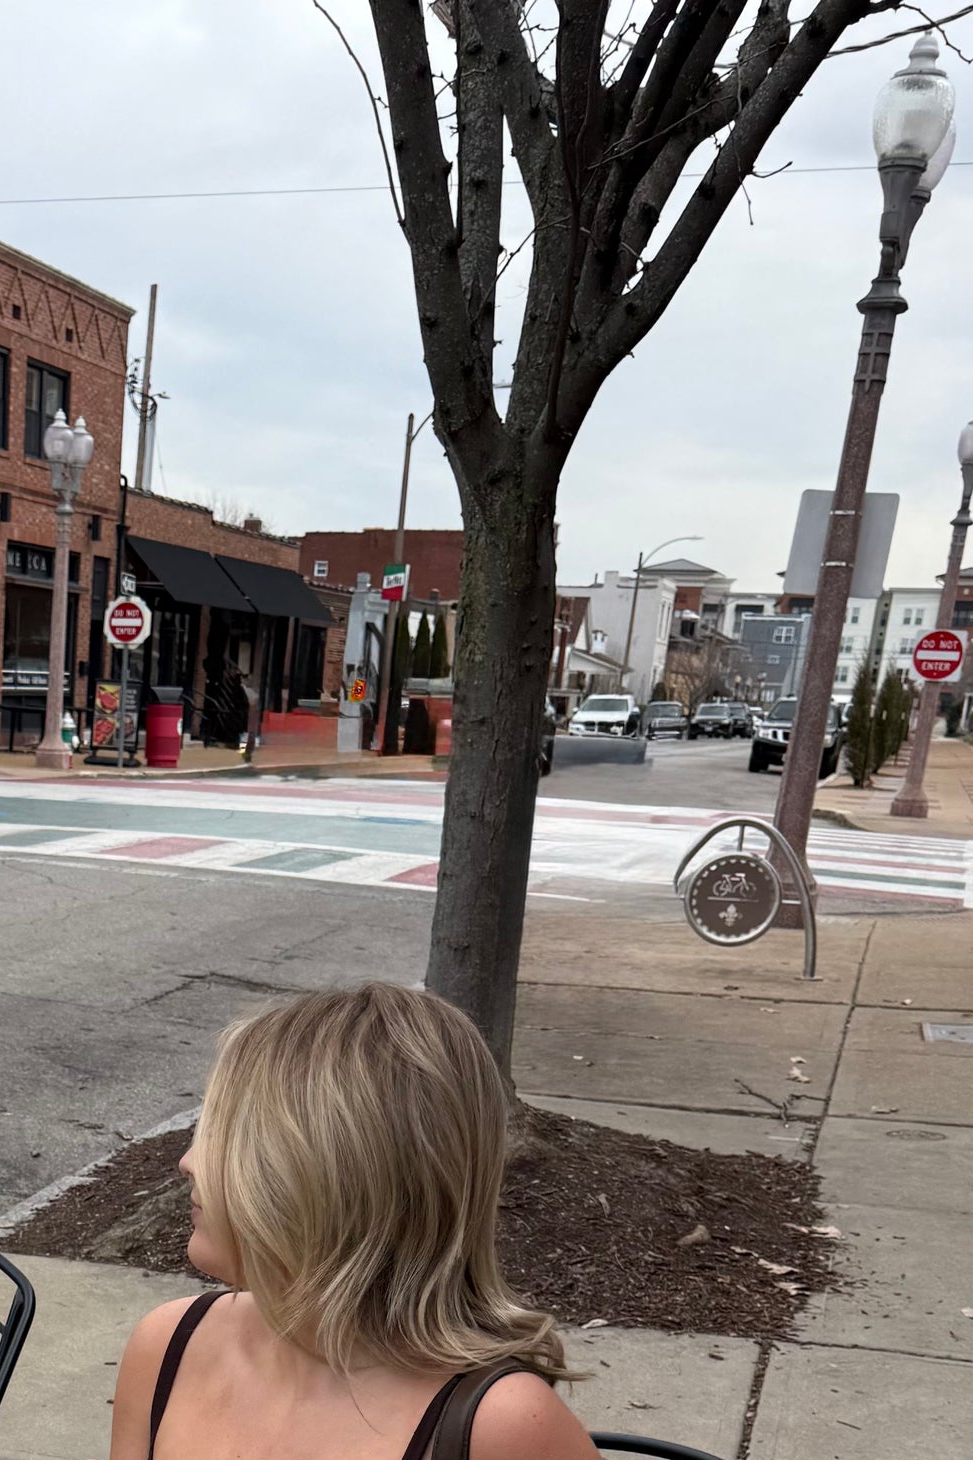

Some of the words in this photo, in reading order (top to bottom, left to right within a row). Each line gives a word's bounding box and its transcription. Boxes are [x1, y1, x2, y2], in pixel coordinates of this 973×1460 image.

[115, 627, 136, 635] ENTER
[922, 640, 935, 649] DO
[939, 640, 959, 650] NOT
[921, 661, 951, 671] ENTER
